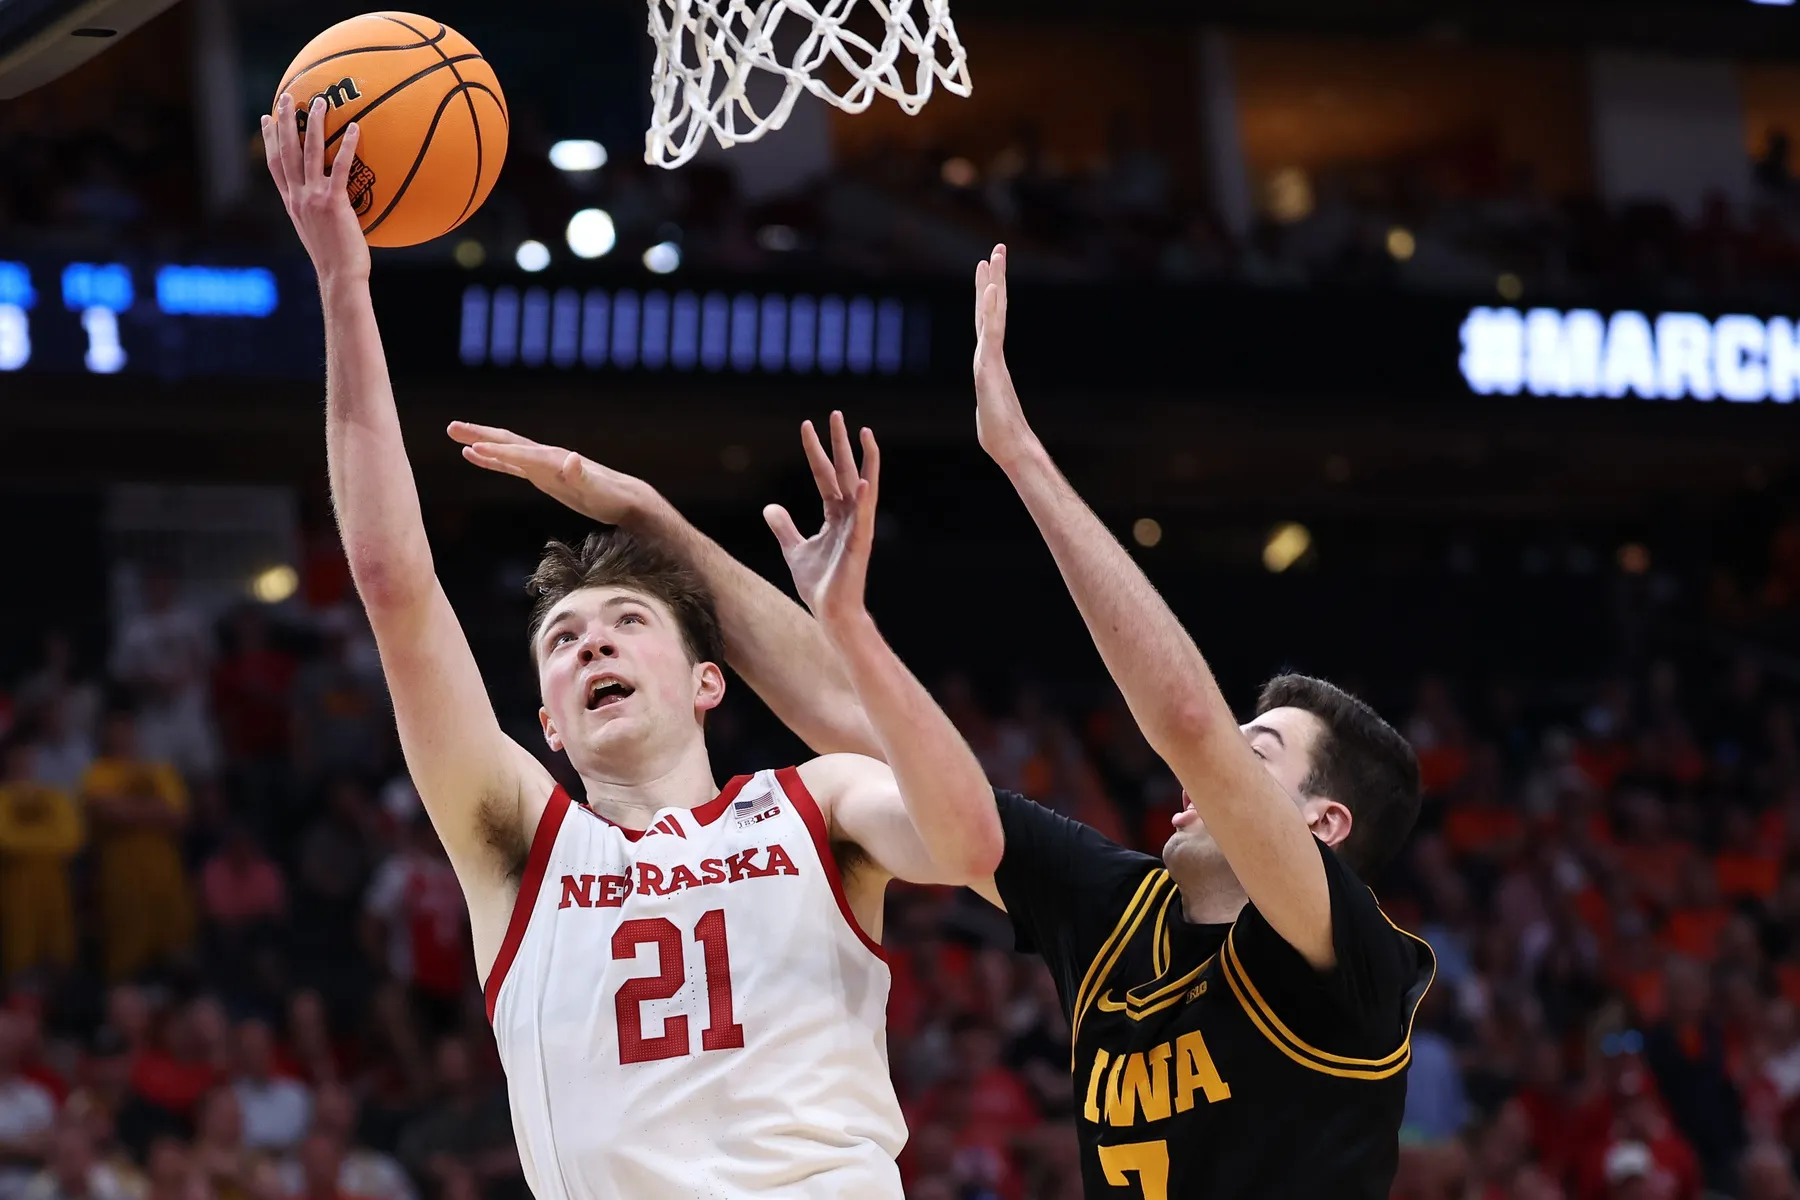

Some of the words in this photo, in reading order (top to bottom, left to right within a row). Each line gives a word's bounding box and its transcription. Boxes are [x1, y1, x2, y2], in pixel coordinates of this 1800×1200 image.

[559, 844, 799, 910] NEBRASKA
[611, 909, 744, 1065] 21
[1084, 1030, 1231, 1126] IWA
